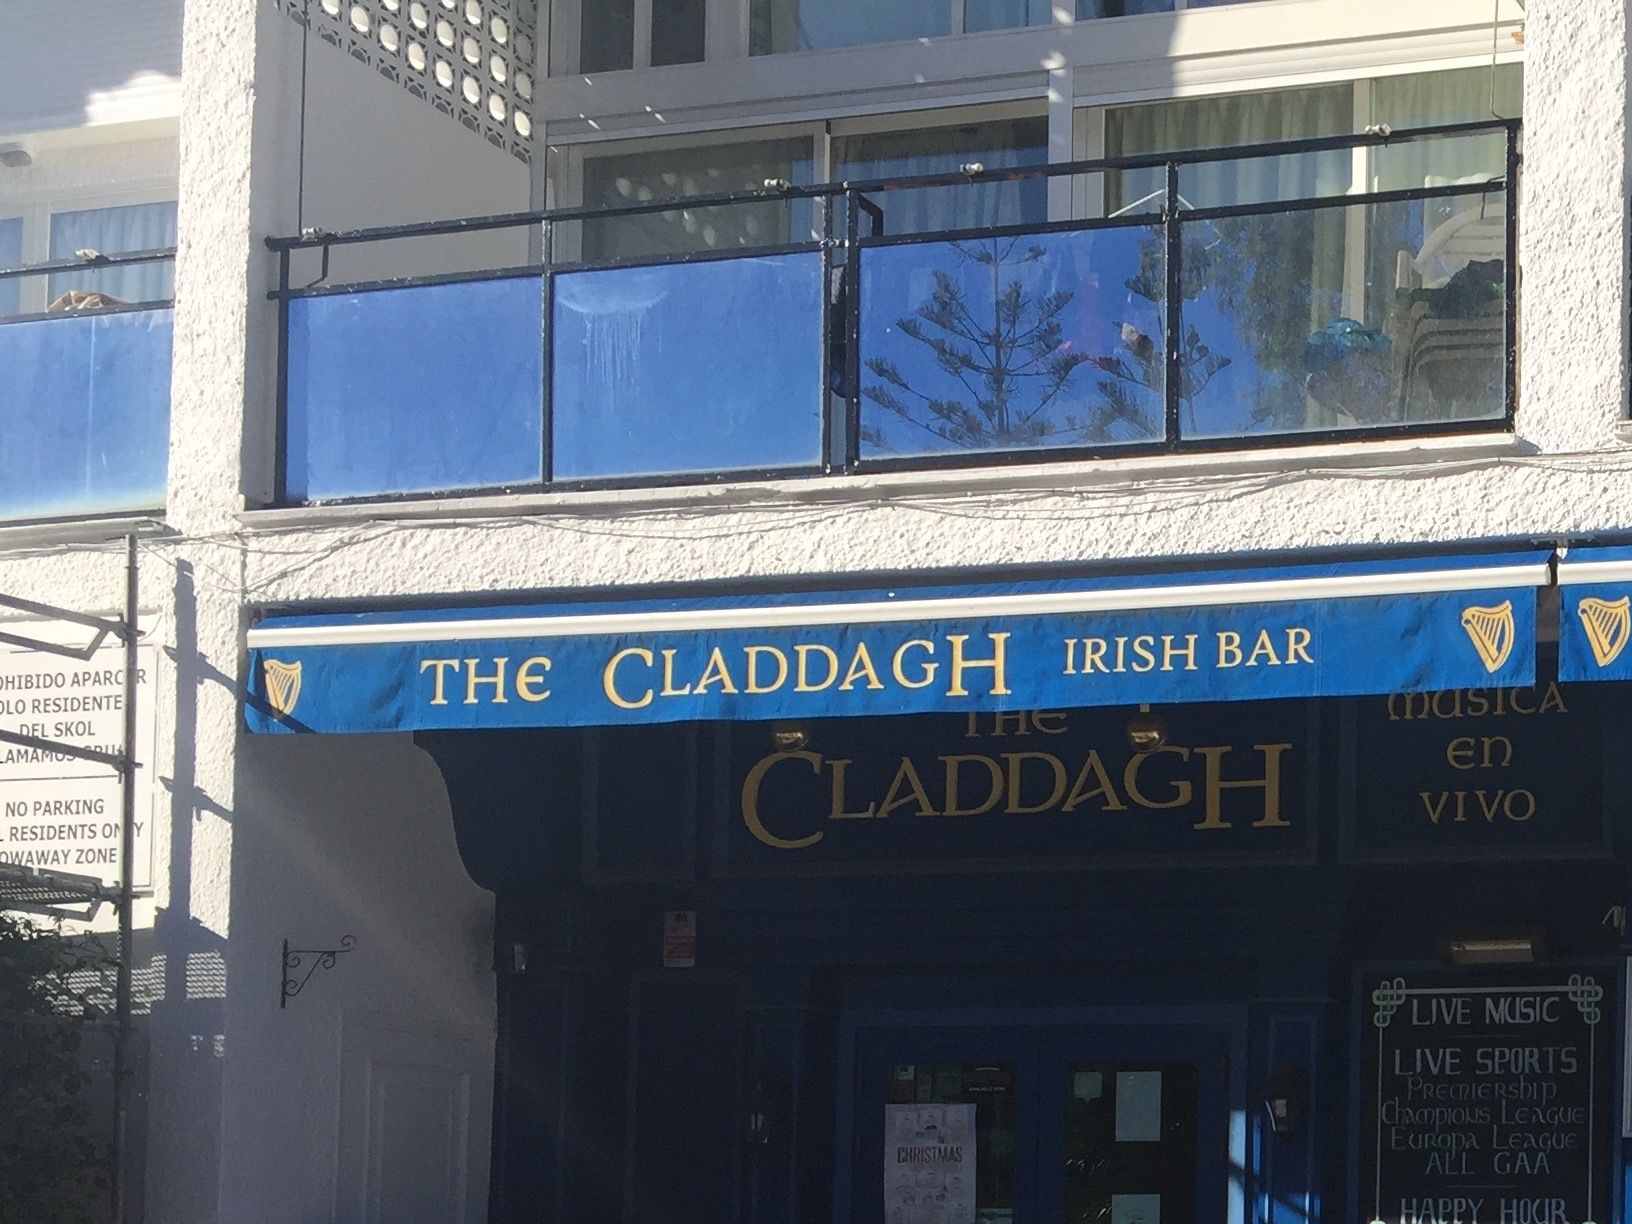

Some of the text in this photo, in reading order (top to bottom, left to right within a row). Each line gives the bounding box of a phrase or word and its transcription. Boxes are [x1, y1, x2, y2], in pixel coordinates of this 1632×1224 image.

[70, 669, 147, 688] APARCR
[420, 626, 1315, 709] THE CLADDAGH IRISH BAR
[20, 720, 96, 738] DEL SKOL
[5, 799, 104, 817] NO PARKING
[741, 743, 1293, 849] CLADDAGH
[1419, 788, 1536, 824] VIVO
[9, 822, 144, 842] RESIDENTS ONY
[75, 848, 117, 865] ZONE
[1411, 996, 1560, 1026] LIVE MUSIC
[1394, 1046, 1578, 1076] LIVE SPORTS
[897, 1146, 962, 1164] CHRISTMAS
[1425, 1151, 1550, 1175] ALL GAA
[1400, 1198, 1485, 1224] HAPPY
